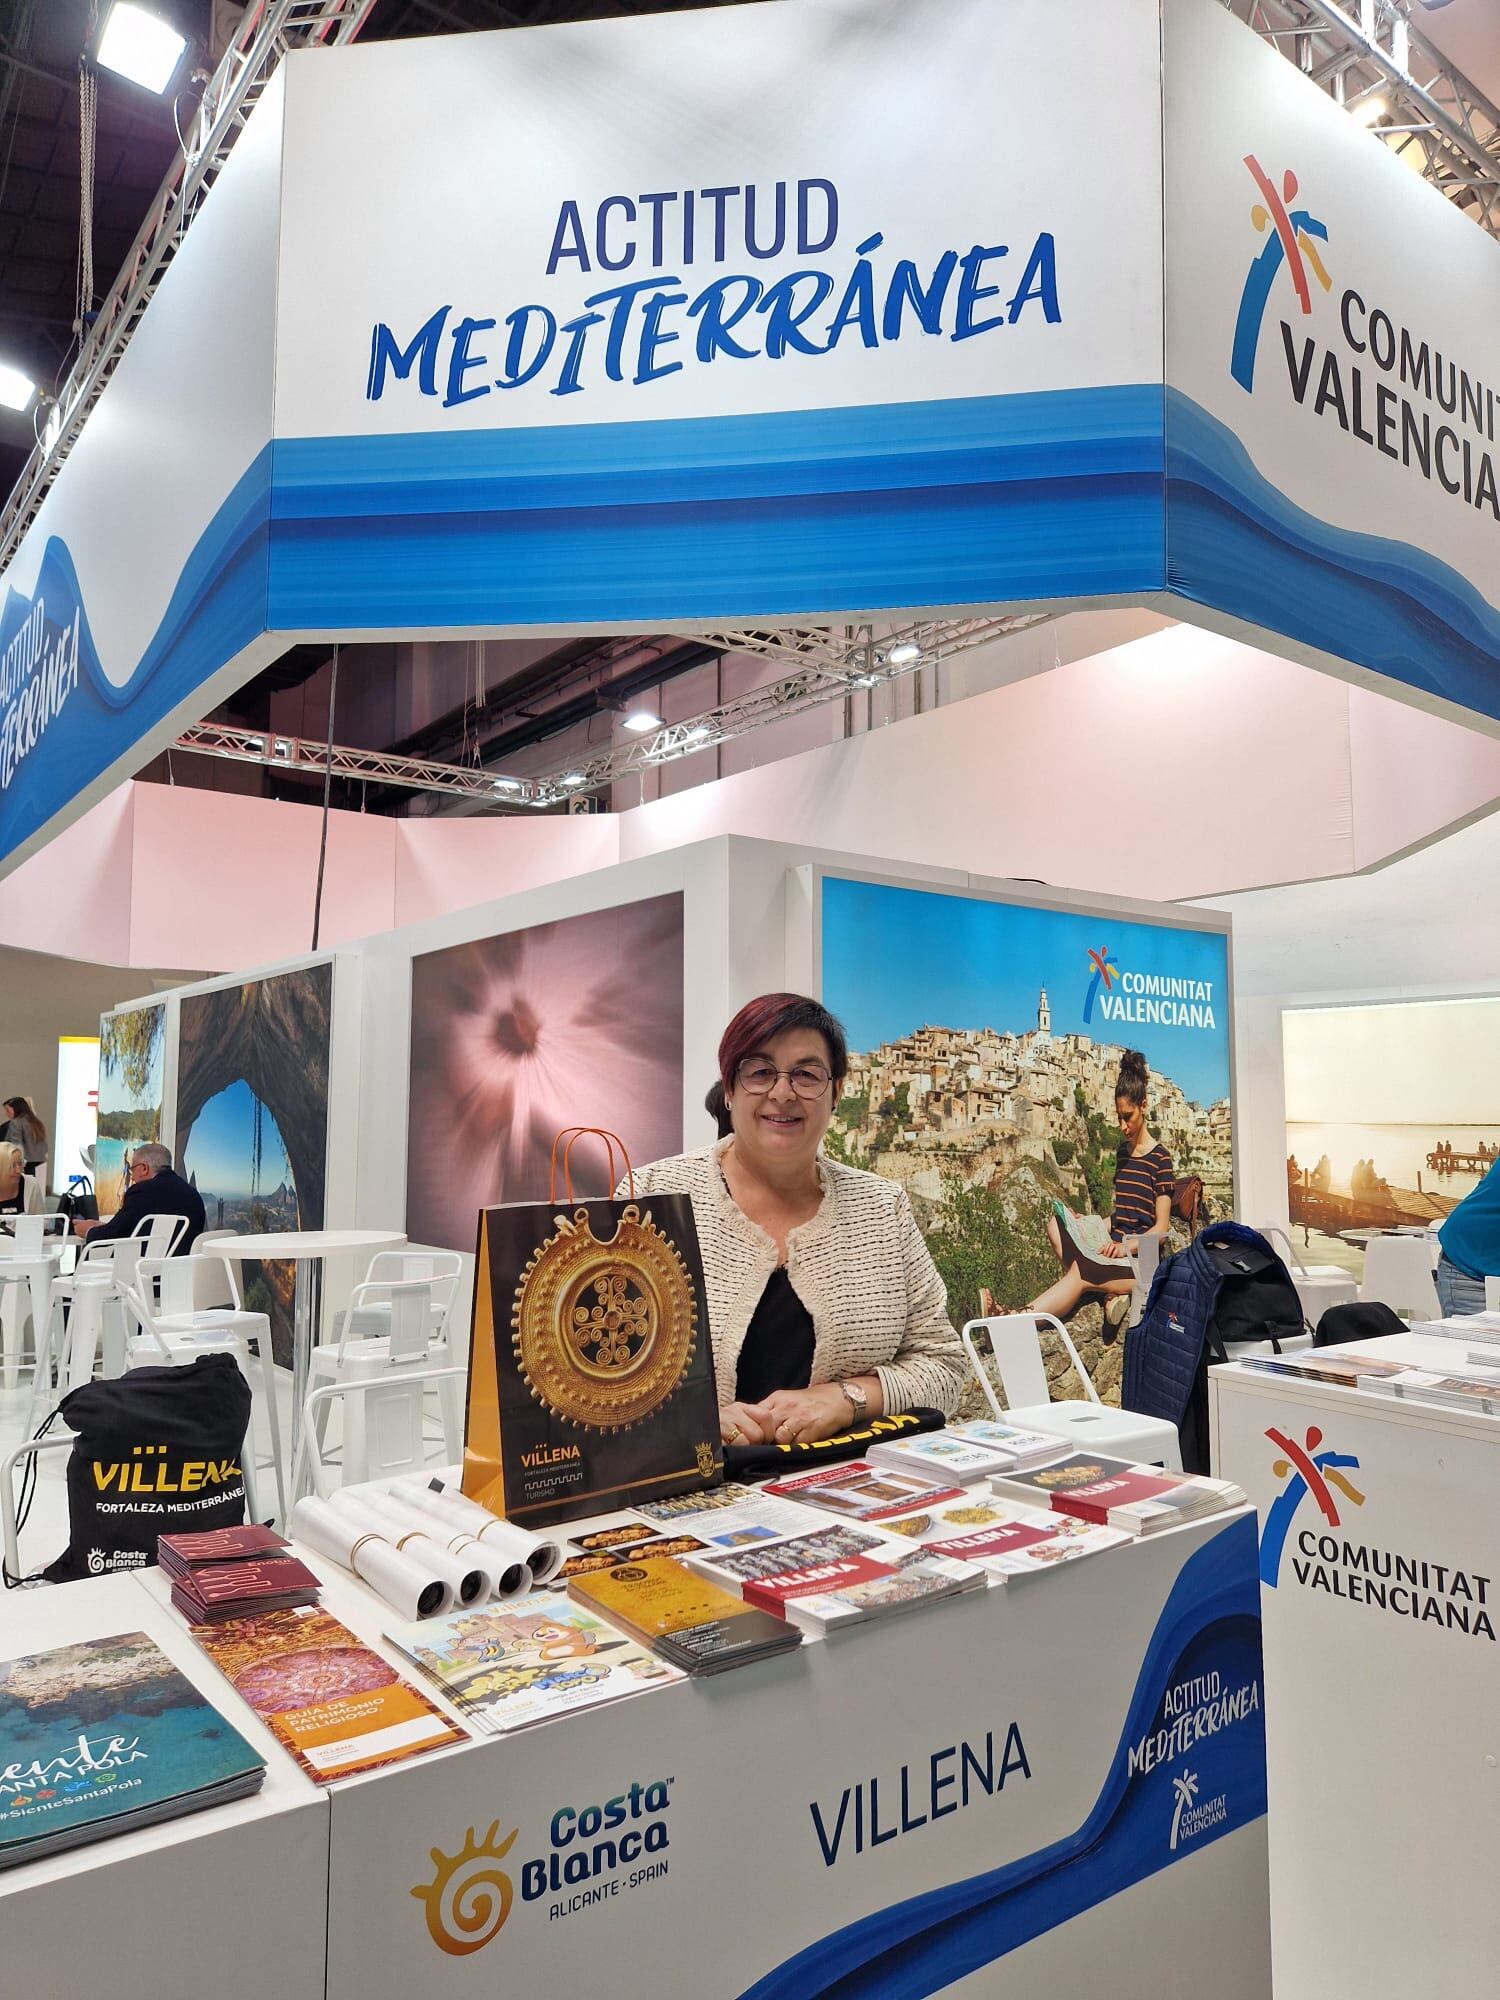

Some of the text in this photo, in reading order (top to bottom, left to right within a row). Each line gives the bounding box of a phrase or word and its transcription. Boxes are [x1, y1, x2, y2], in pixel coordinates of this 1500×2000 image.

[545, 177, 840, 275] ACTITUD
[366, 231, 1062, 408] MEDITERRÁNEA
[1340, 289, 1500, 442] COMUNI
[1121, 972, 1213, 1002] COMUNITAT
[1099, 995, 1216, 1029] VALENCIANA
[521, 1445, 580, 1467] VILLENA
[526, 1488, 555, 1500] TURISMO
[1062, 1480, 1130, 1497] VILLENA
[96, 1502, 165, 1513] FORTALEZA
[113, 1550, 148, 1560] Costa
[933, 1528, 1021, 1550] VILLENA
[105, 1558, 146, 1568] Blanca
[755, 1562, 861, 1589] VILLENA
[1298, 1529, 1491, 1604] COMUNITAT
[1291, 1557, 1497, 1642] VALENCIANA
[327, 1701, 350, 1711] DE
[1164, 1671, 1220, 1719] ACTITUD
[289, 1698, 384, 1727] PATRIMONIO
[1127, 1680, 1259, 1778] MEDITERRÁNEA
[77, 1750, 148, 1776] POLA
[0, 1778, 142, 1821] #SienteSantaPola
[809, 1721, 1033, 1867] VILLENA
[1181, 1794, 1227, 1826] COMUNITAT
[550, 1781, 670, 1848] Costa
[1179, 1808, 1227, 1841] VALENCIANA
[521, 1821, 670, 1901] Blanca
[550, 1860, 669, 1920] ALICANTE SPAIN
